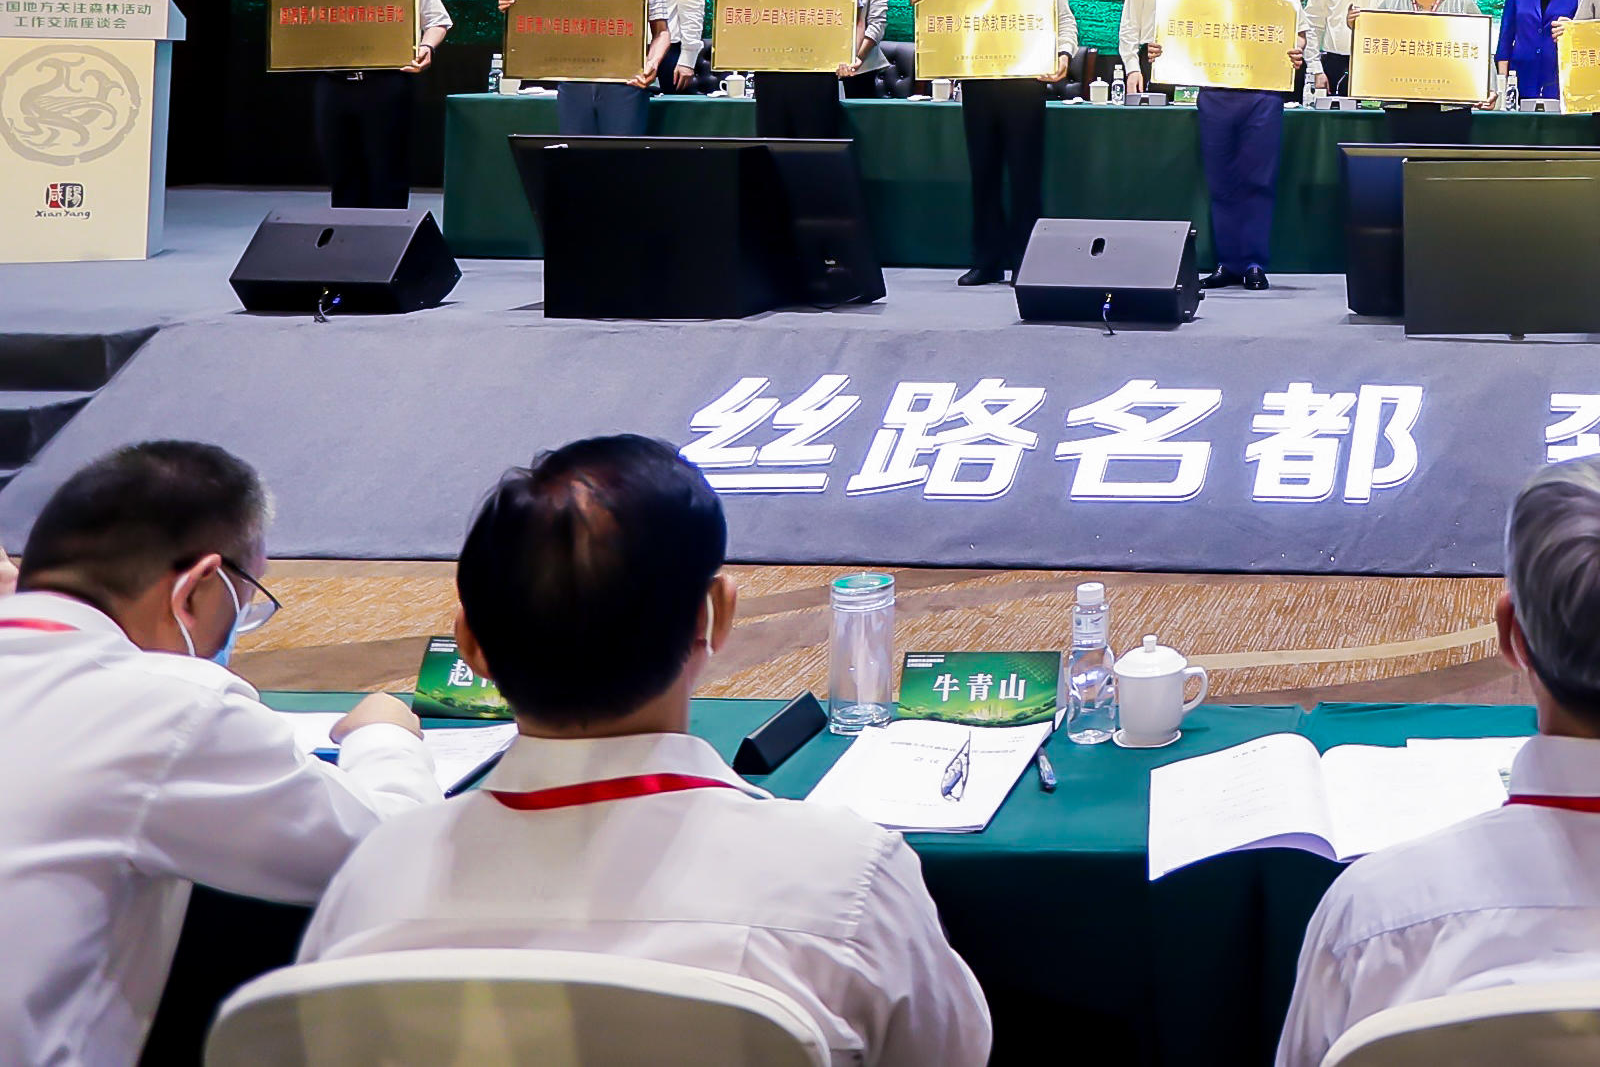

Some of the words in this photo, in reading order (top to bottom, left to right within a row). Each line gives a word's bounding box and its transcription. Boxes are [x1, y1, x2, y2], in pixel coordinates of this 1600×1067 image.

[0, 0, 152, 15] 国地方关注森林活动
[15, 16, 128, 29] 工作交流座谈会
[677, 374, 1424, 504] 丝路名都
[932, 673, 1026, 702] 牛青山
